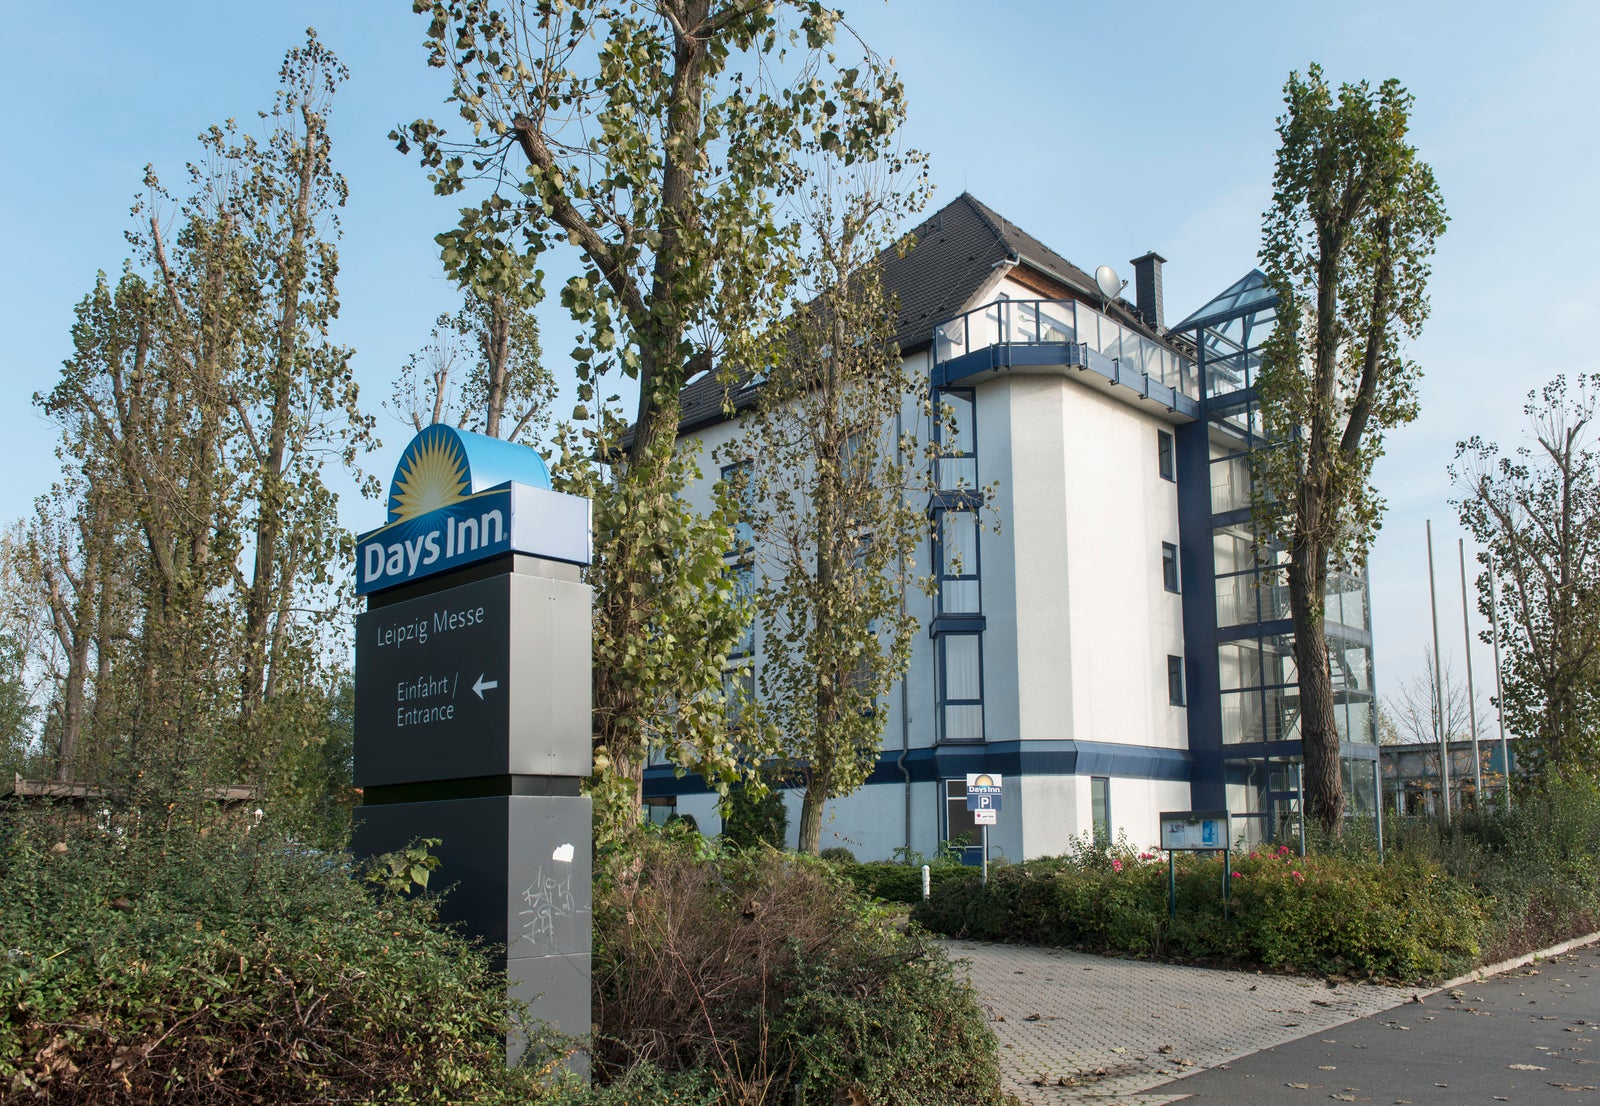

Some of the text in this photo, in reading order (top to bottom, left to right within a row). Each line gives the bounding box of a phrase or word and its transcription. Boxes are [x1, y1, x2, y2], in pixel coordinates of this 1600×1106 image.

[364, 509, 503, 583] Days Inn
[377, 607, 485, 648] Leipzig Messe
[397, 675, 448, 701] Einfahrt
[397, 705, 454, 727] Entrance
[969, 786, 987, 794] Days
[980, 797, 989, 808] P
